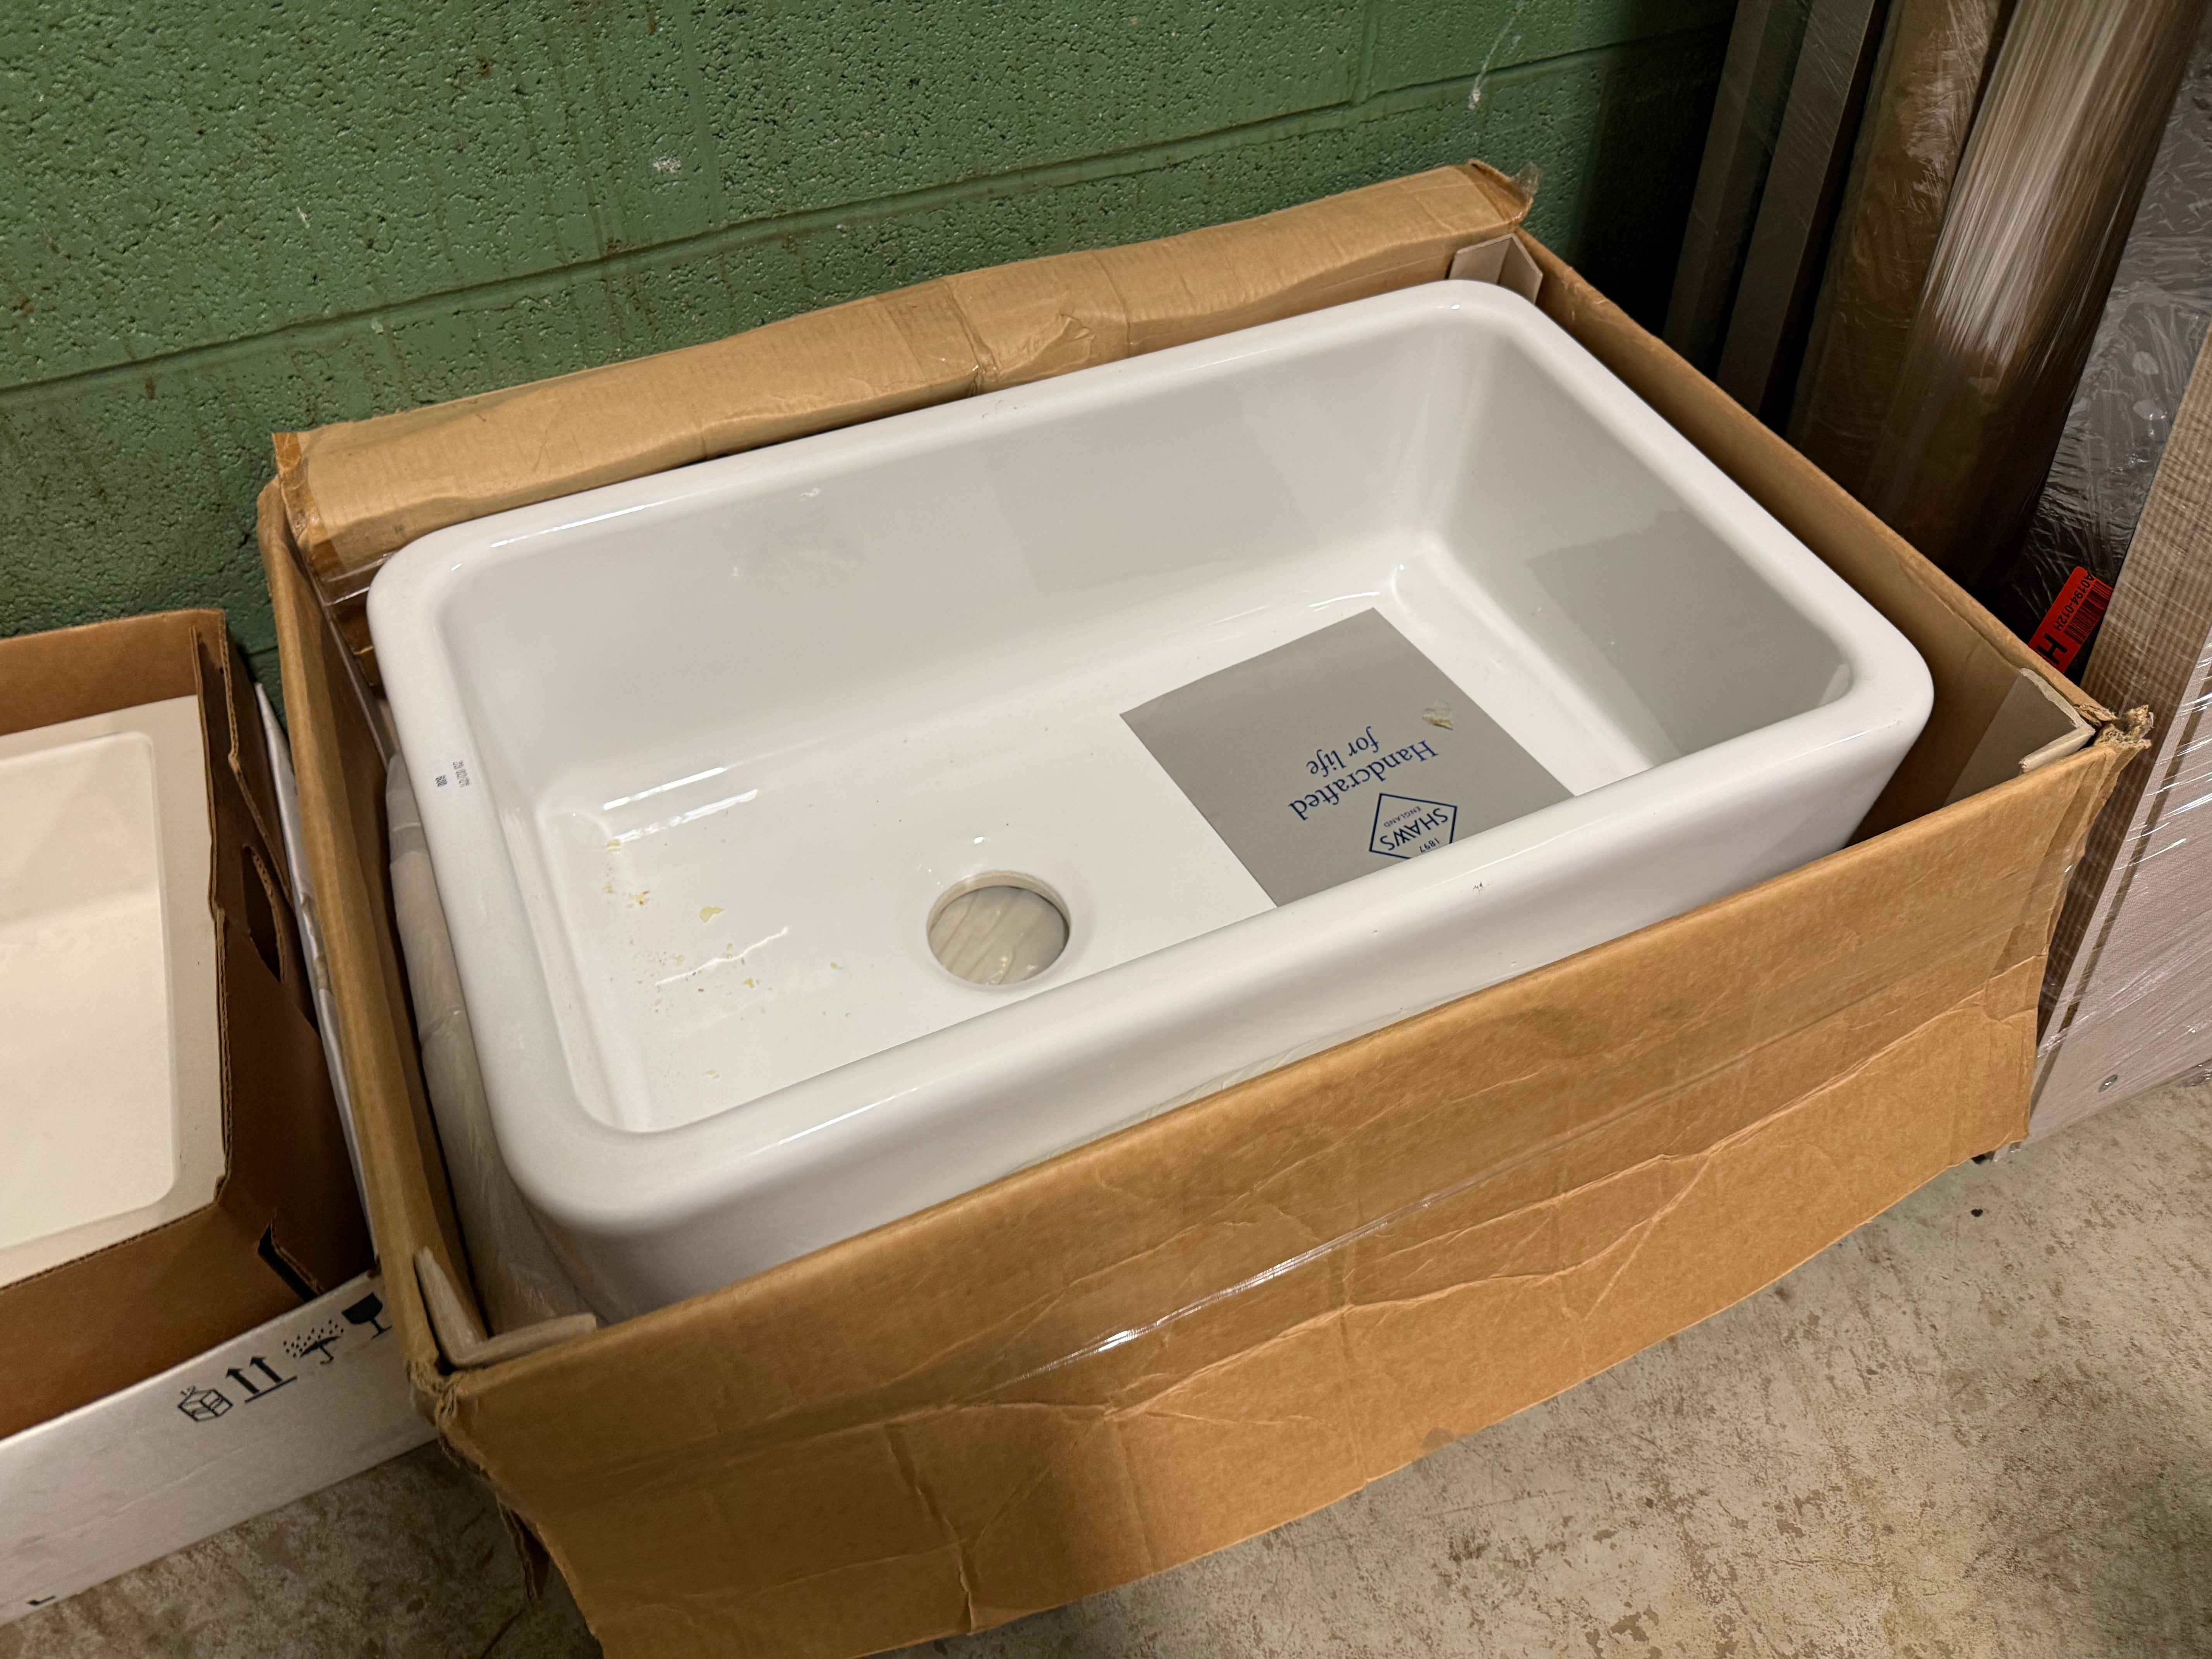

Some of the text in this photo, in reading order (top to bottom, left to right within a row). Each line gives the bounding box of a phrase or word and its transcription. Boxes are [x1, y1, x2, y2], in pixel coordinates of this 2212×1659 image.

[2054, 571, 2094, 631] A0194-012H
[2037, 634, 2068, 665] H
[1306, 726, 1379, 777] for life
[1288, 740, 1438, 820] Handcrafted
[1380, 808, 1448, 850] SHAWS
[1384, 806, 1422, 828] ENGLAND
[1419, 838, 1440, 852] 1897
